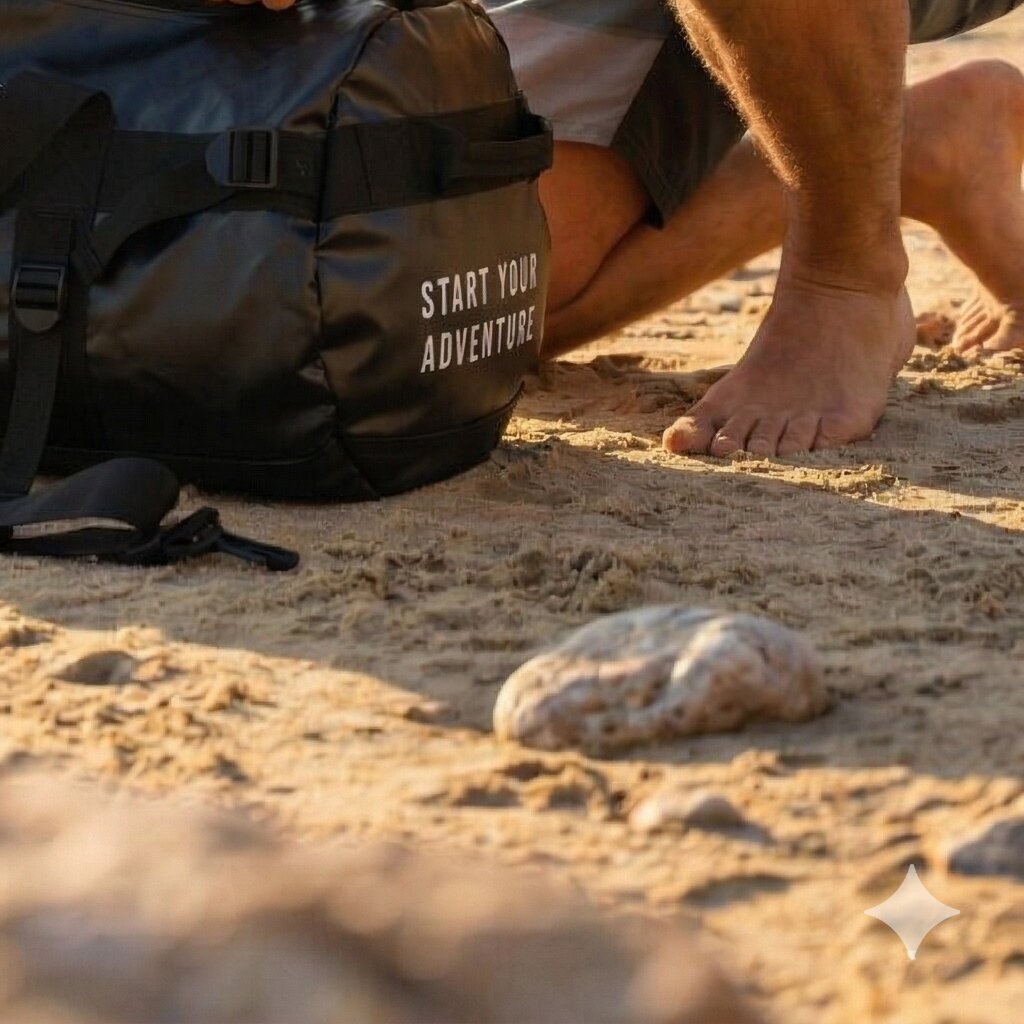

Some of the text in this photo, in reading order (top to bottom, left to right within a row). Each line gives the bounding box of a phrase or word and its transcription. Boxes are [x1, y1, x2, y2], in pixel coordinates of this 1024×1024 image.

[421, 253, 537, 319] START YOUR
[420, 305, 535, 373] ADVENTURE
